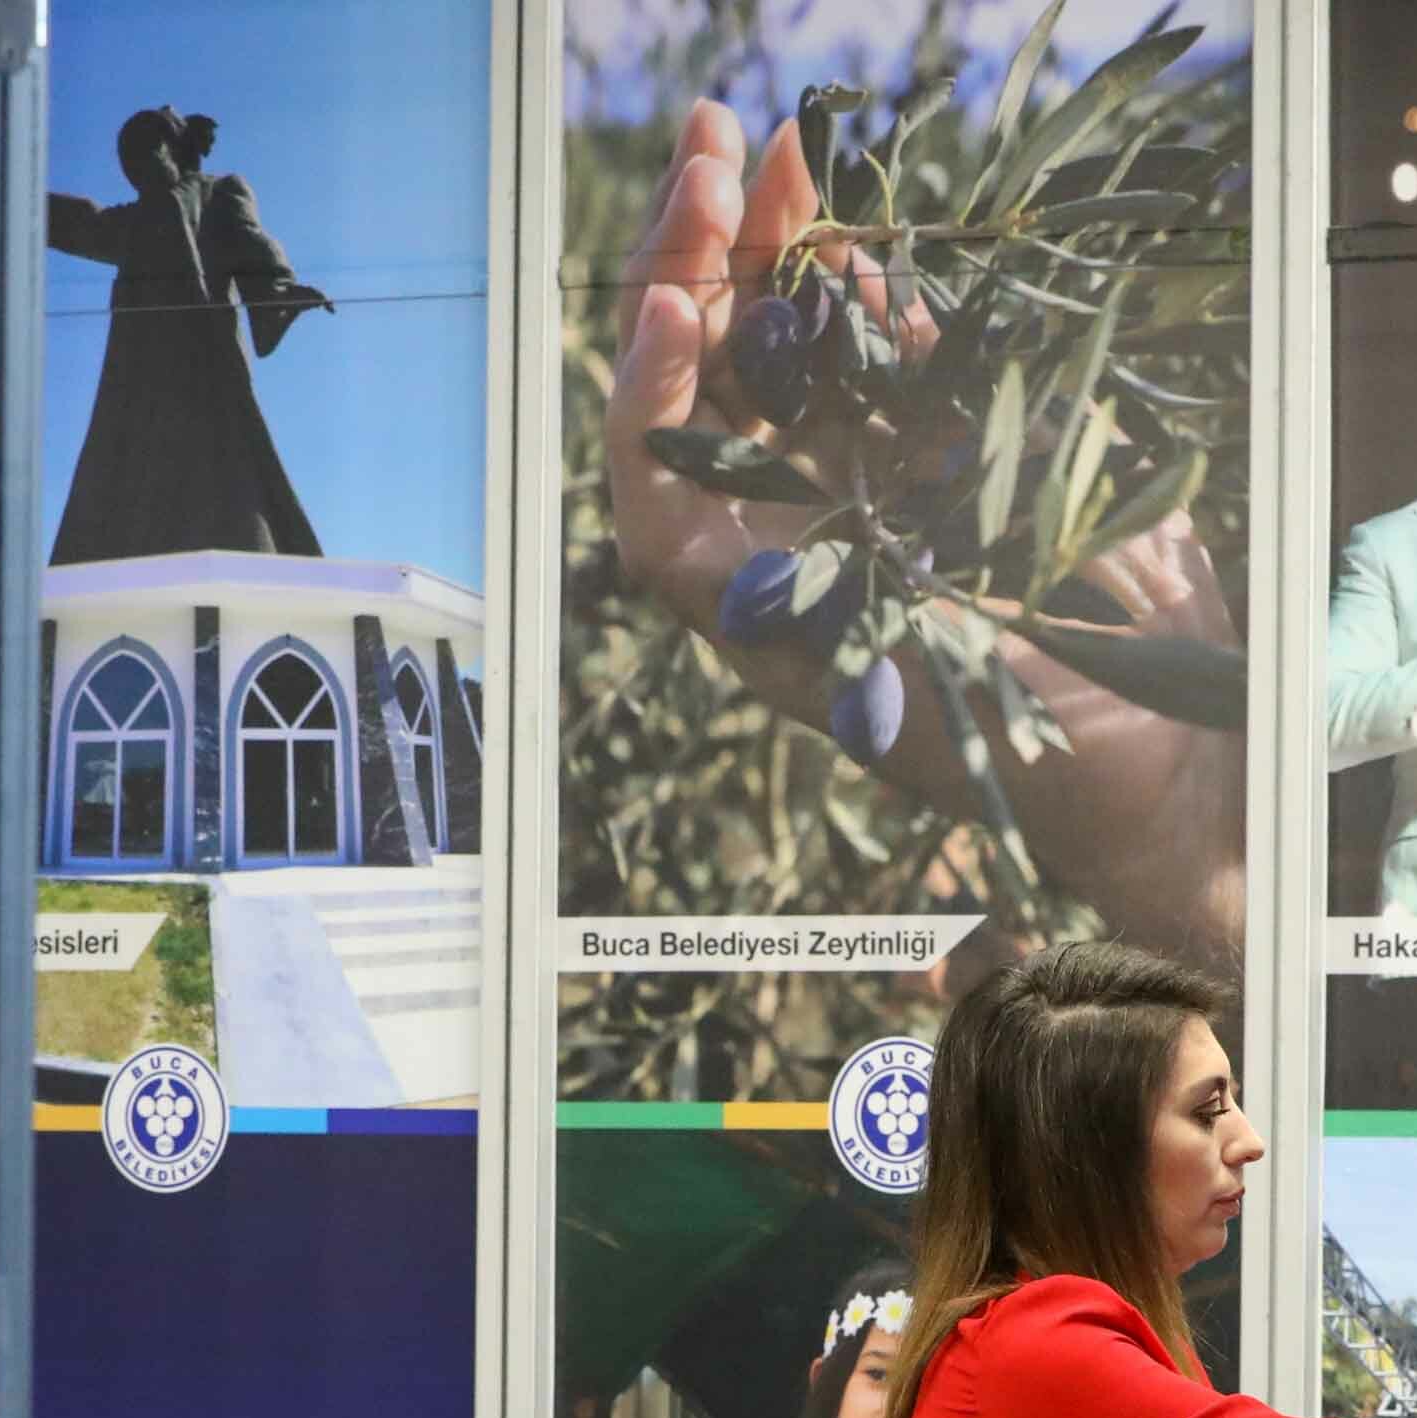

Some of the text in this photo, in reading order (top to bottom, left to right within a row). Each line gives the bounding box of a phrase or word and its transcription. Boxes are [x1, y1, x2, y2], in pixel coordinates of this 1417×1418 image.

[582, 930, 935, 961] Buca Belediyesi Zeytinliği
[131, 1056, 198, 1080] BUCA
[115, 1138, 216, 1182] BELEDİYESİ
[843, 1137, 924, 1183] BELEDİ
